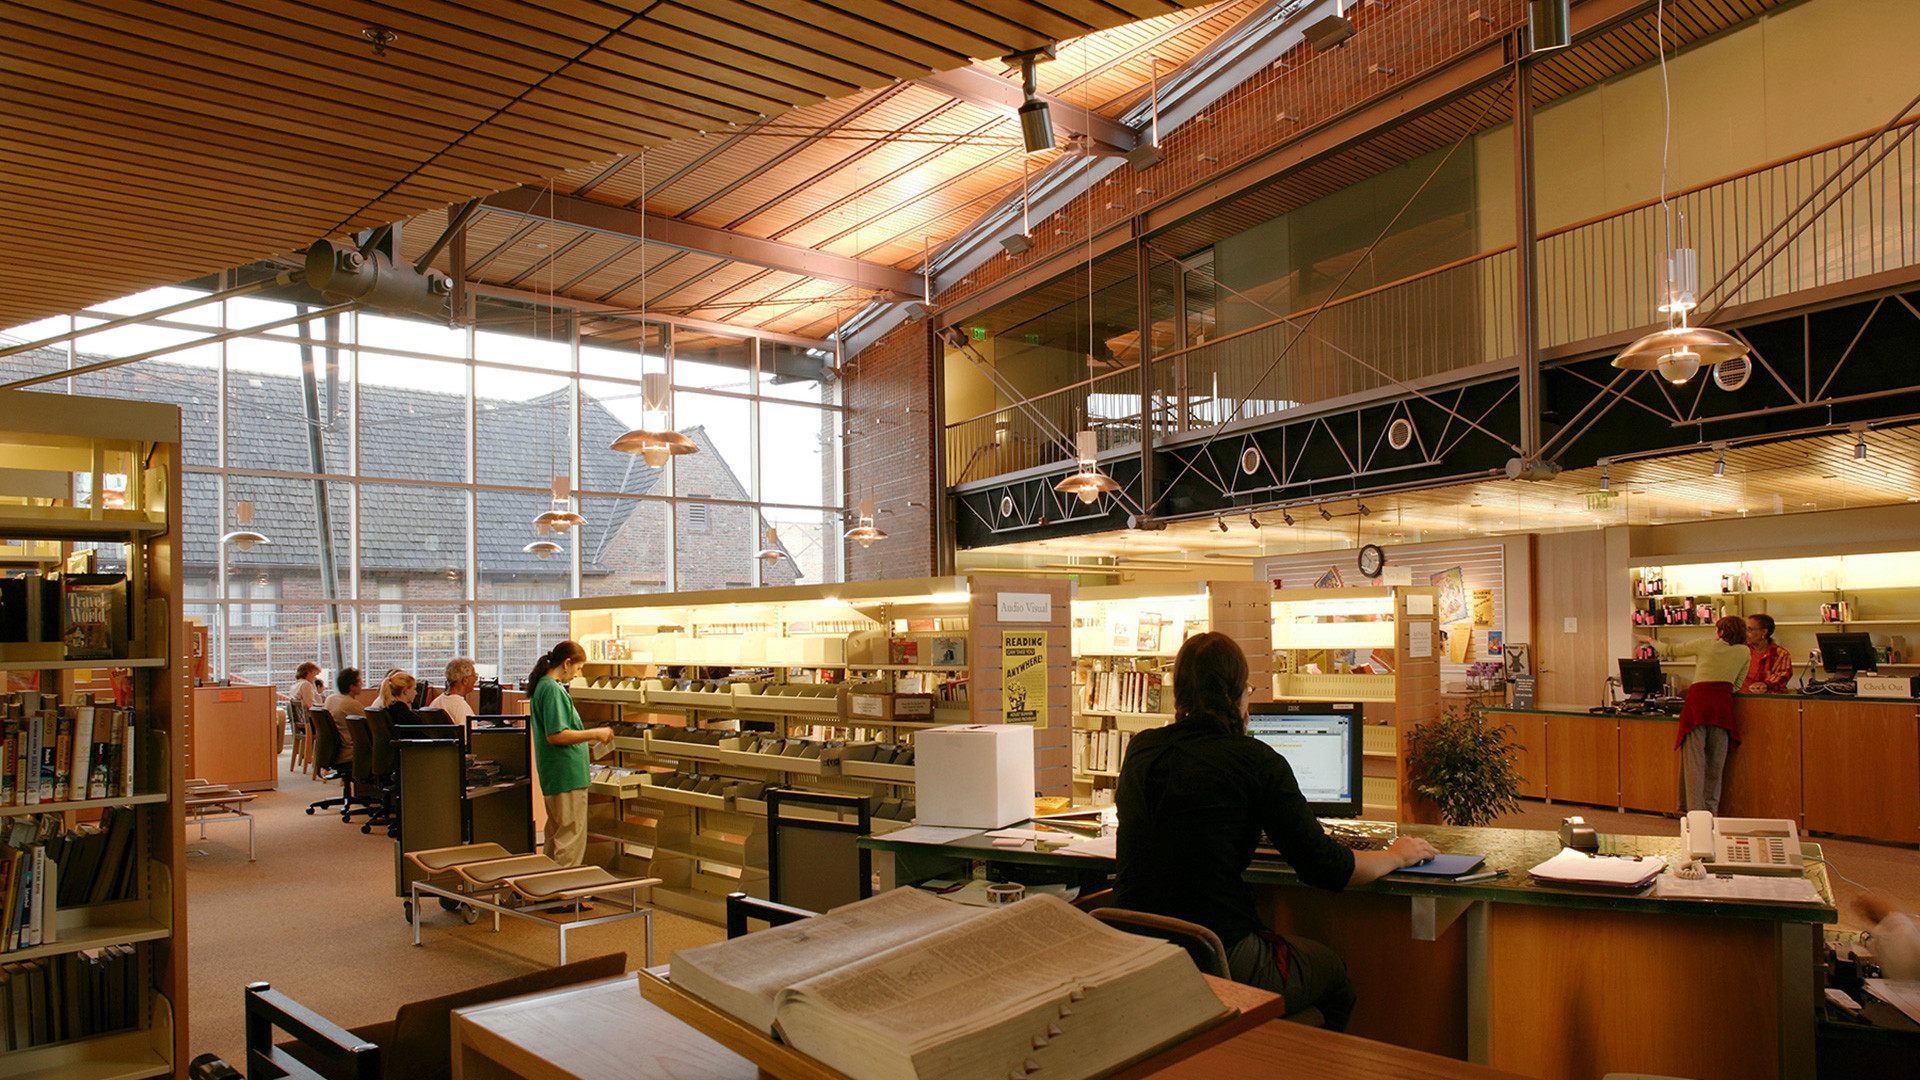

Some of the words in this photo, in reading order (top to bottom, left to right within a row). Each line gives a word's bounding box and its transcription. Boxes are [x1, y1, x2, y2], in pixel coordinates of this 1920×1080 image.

[67, 592, 105, 607] Travel
[1001, 601, 1024, 612] Audio
[1026, 602, 1048, 613] Visual
[70, 607, 105, 623] World
[1006, 637, 1042, 647] READING
[1863, 682, 1886, 691] Check
[1888, 683, 1903, 691] Out
